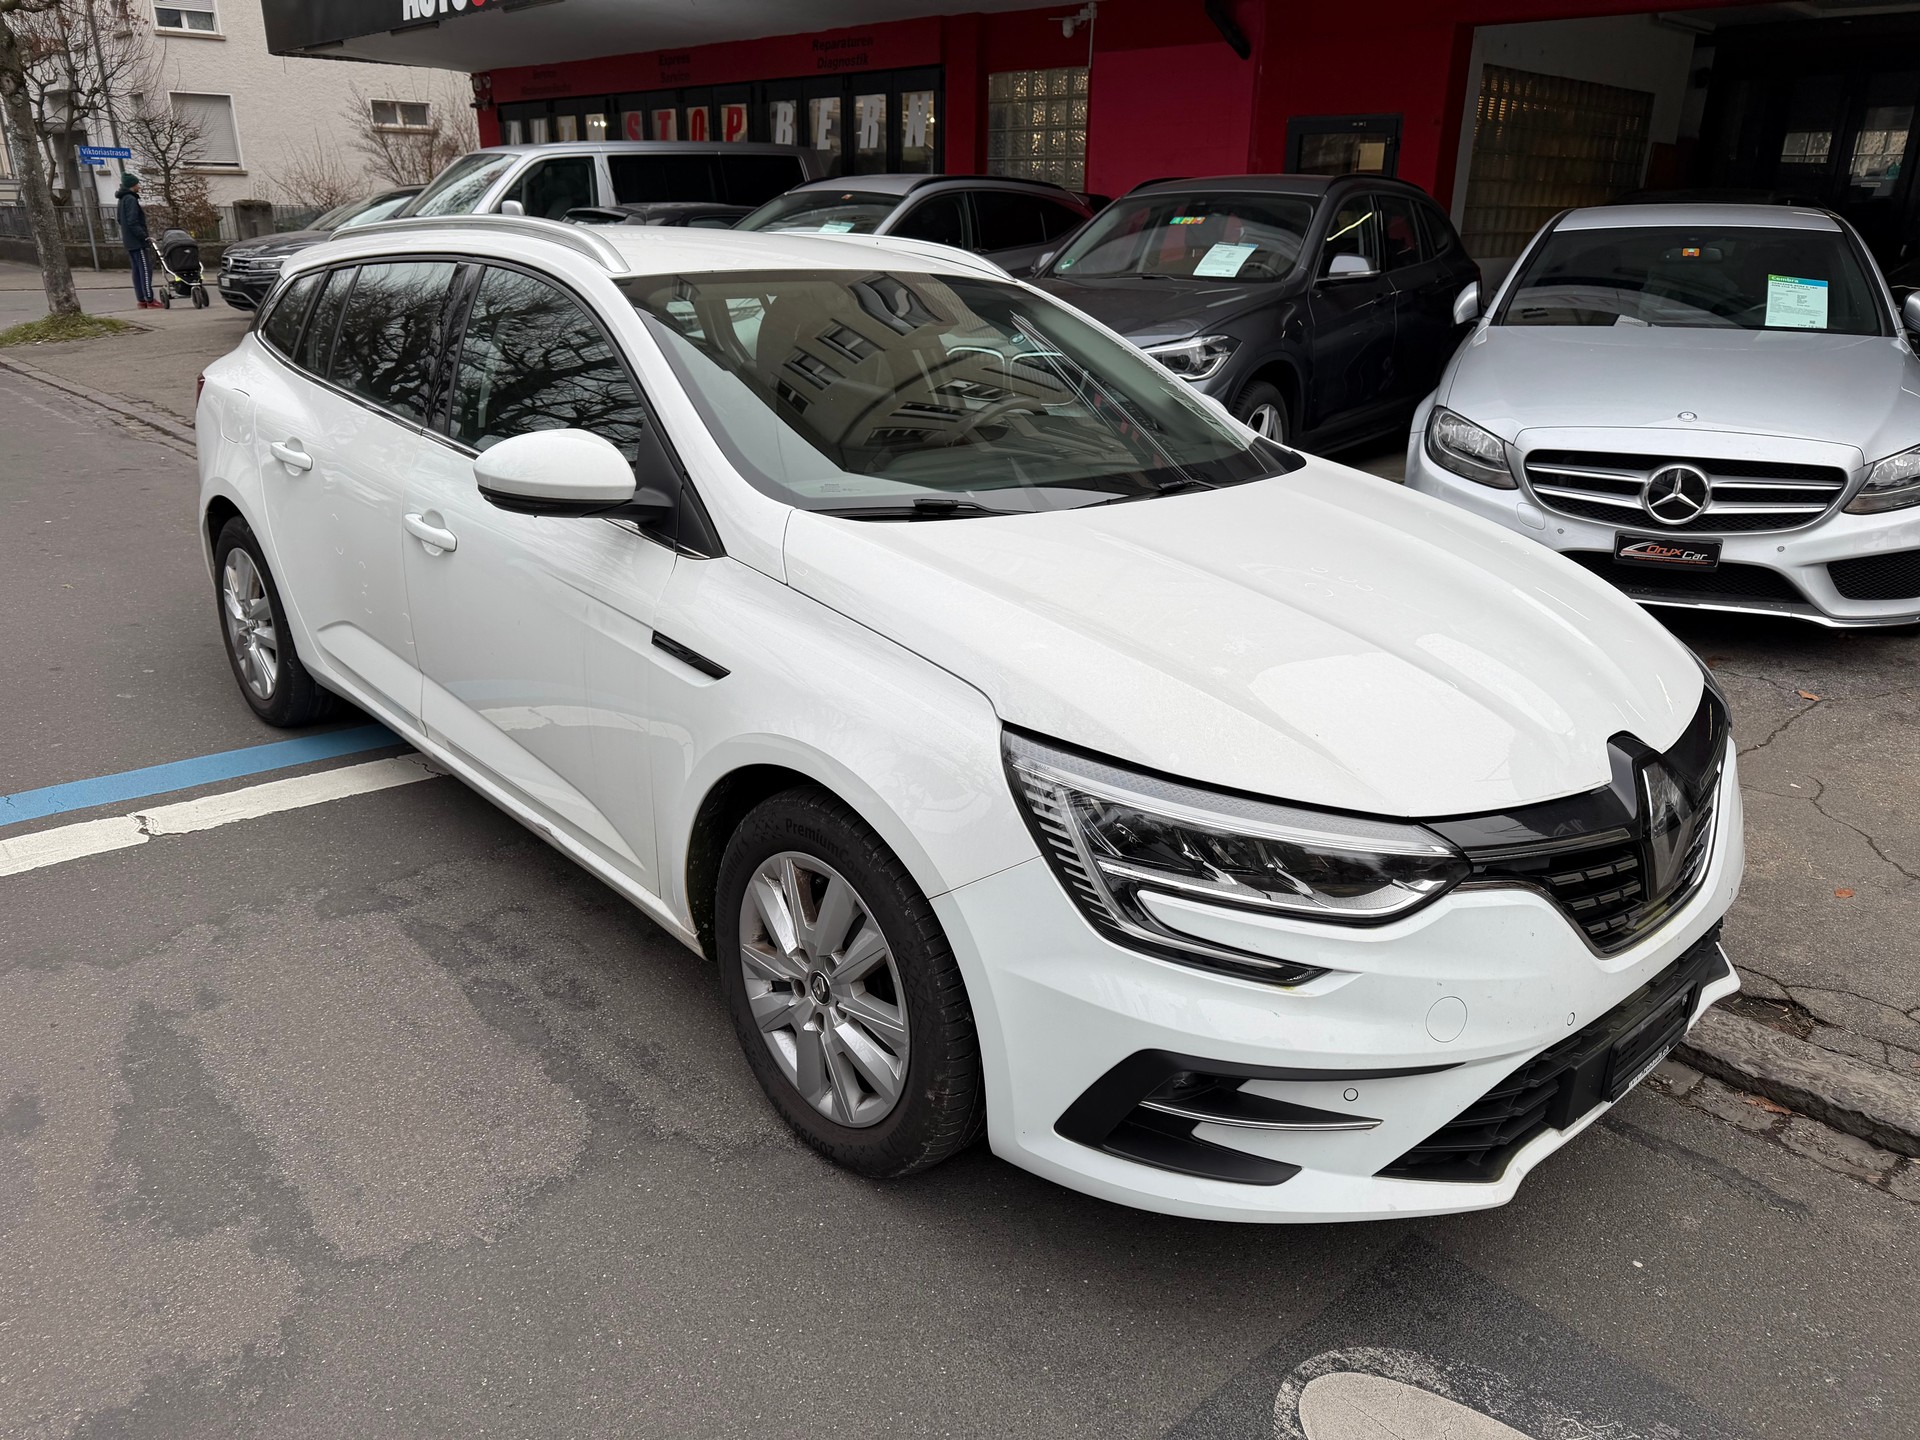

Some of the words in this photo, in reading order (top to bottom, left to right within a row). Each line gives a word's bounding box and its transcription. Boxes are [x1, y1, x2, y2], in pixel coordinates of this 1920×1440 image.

[812, 36, 875, 53] Reparaturen
[658, 53, 691, 68] Express
[816, 52, 870, 70] Diagnostik
[660, 70, 691, 83] Service
[626, 106, 743, 142] STOP
[775, 94, 929, 150] BERN
[81, 147, 129, 156] Viktoriastrasse
[1646, 545, 1683, 556] Oryx
[1682, 551, 1708, 560] Car
